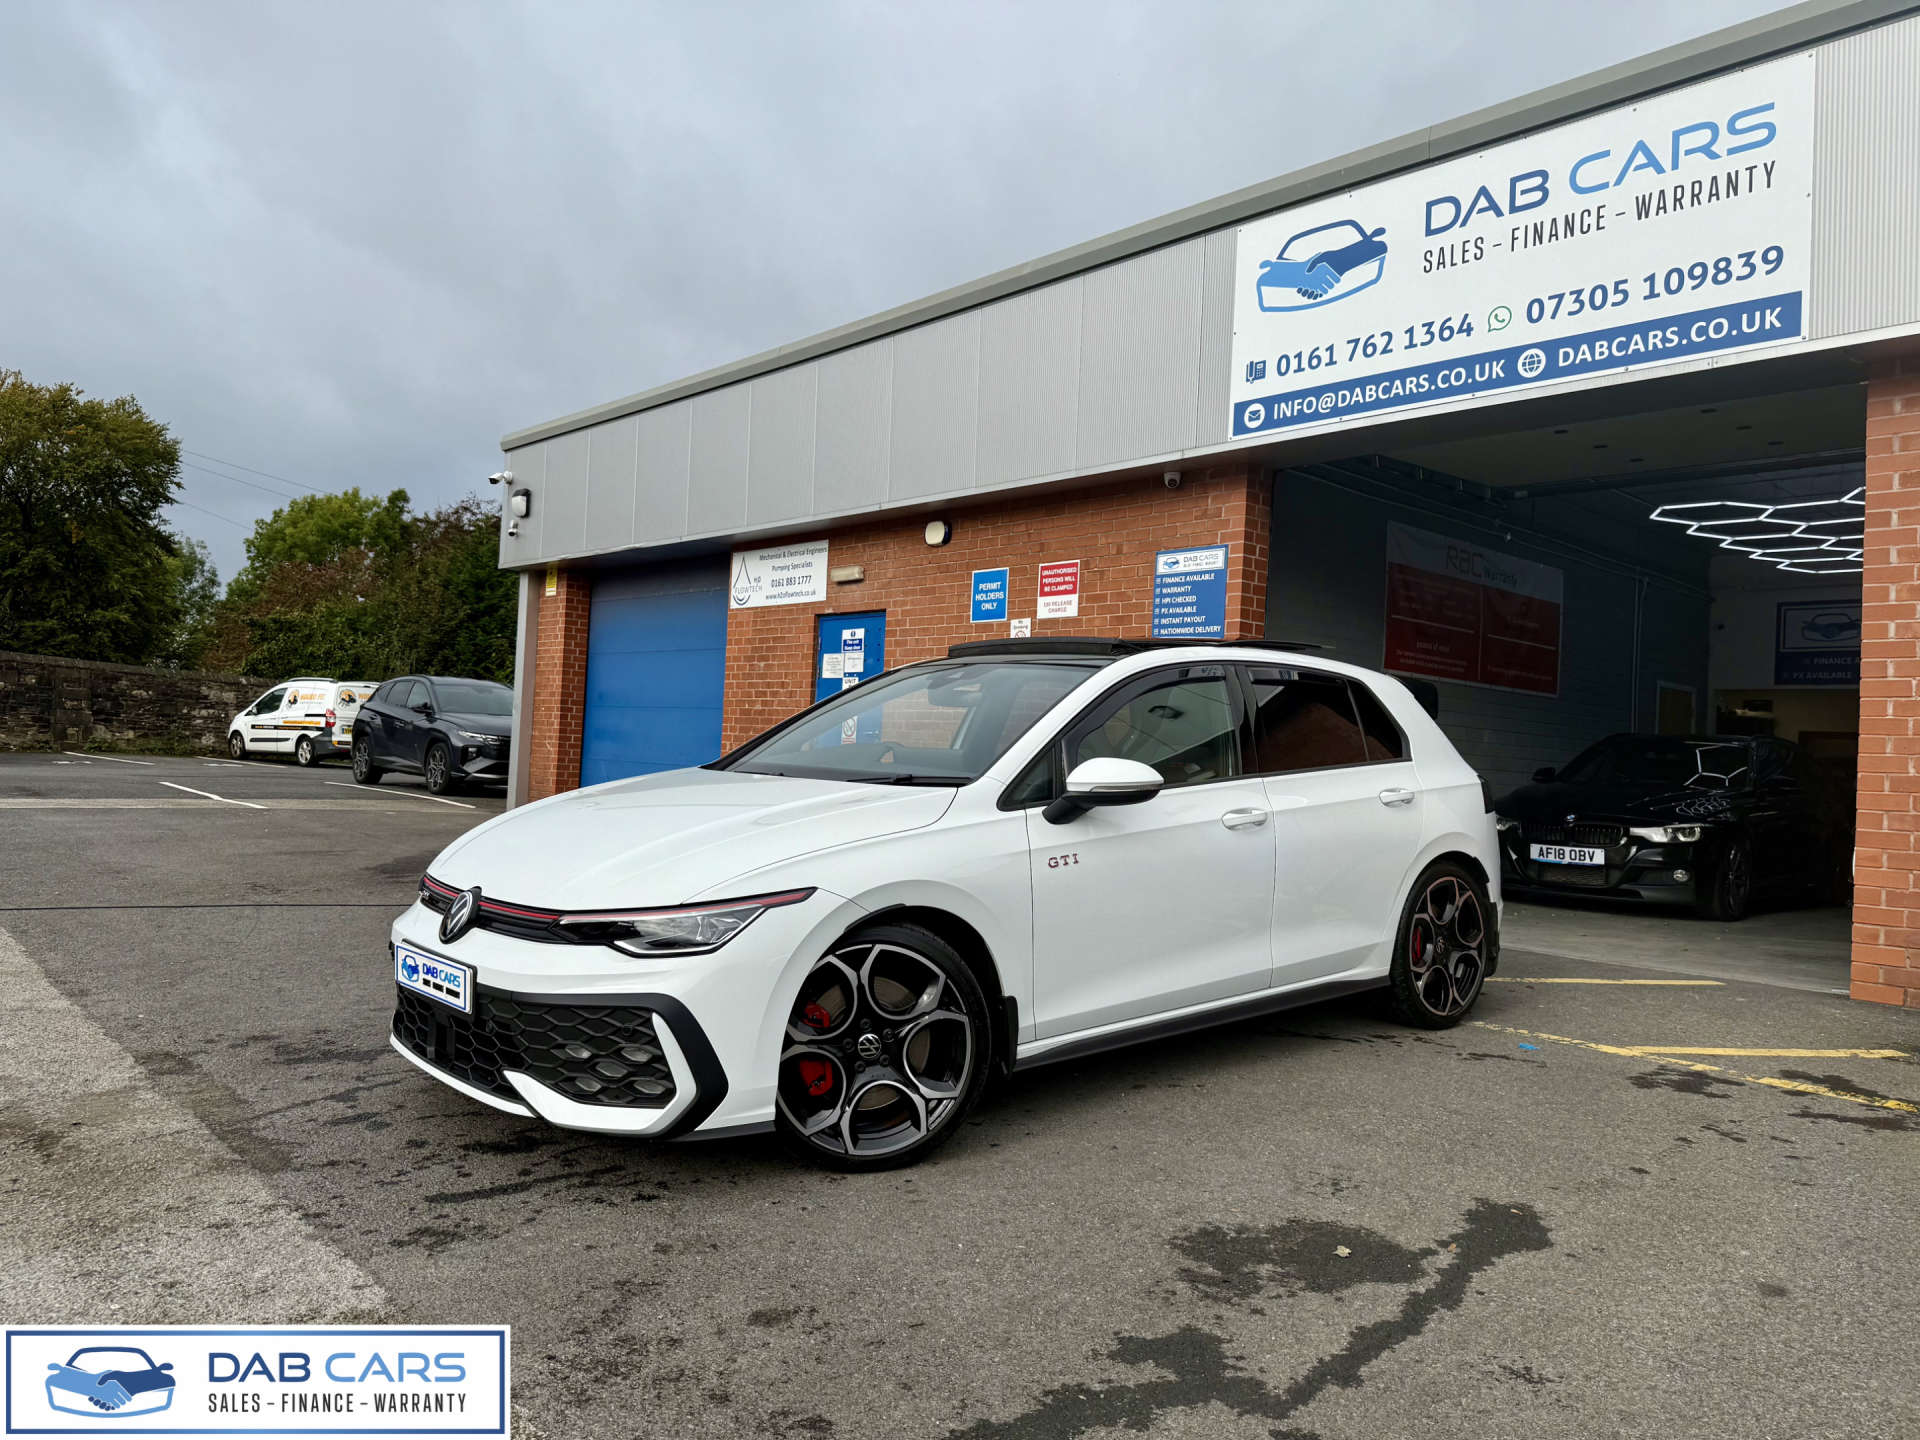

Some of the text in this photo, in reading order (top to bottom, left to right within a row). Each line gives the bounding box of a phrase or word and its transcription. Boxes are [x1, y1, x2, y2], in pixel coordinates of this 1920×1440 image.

[1425, 102, 1777, 237] DAB CARS
[1423, 236, 1484, 274] SALES
[1510, 204, 1606, 252] FINANCE
[1635, 160, 1776, 221] WARRANTY
[1526, 245, 1784, 324] 07305 109839
[1557, 306, 1782, 368] DABCARS.CO.UK
[1276, 313, 1474, 377] 0161 762 1364
[1273, 359, 1505, 420] INFO@DABCARS.CO.UK
[760, 552, 782, 560] Mechanical
[806, 547, 827, 556] Engineers
[1199, 553, 1219, 561] CARS
[791, 561, 813, 570] Specialists
[771, 578, 784, 588] 0161
[797, 575, 812, 585] 1777
[1162, 573, 1215, 584] FINANCE AVAILABLE
[734, 585, 762, 595] FLOWTECH
[979, 581, 1001, 591] PERMIT
[1051, 584, 1073, 592] CLAMPED
[1161, 585, 1192, 594] WARRANTY
[976, 592, 1004, 601] HOLDERS
[1172, 595, 1197, 603] CHECKED
[981, 602, 998, 610] ONLY
[1169, 605, 1197, 613] AVAILABLE
[1160, 617, 1183, 625] INSTANT
[1160, 625, 1221, 635] NATIONWIDE DELIVERY
[1814, 656, 1852, 665] FINANCE
[1806, 671, 1852, 680] AVAILABLE
[1538, 846, 1595, 862] AF18 OBV
[1048, 853, 1079, 868] GTI
[422, 962, 438, 979] DAB
[438, 969, 461, 989] CARS
